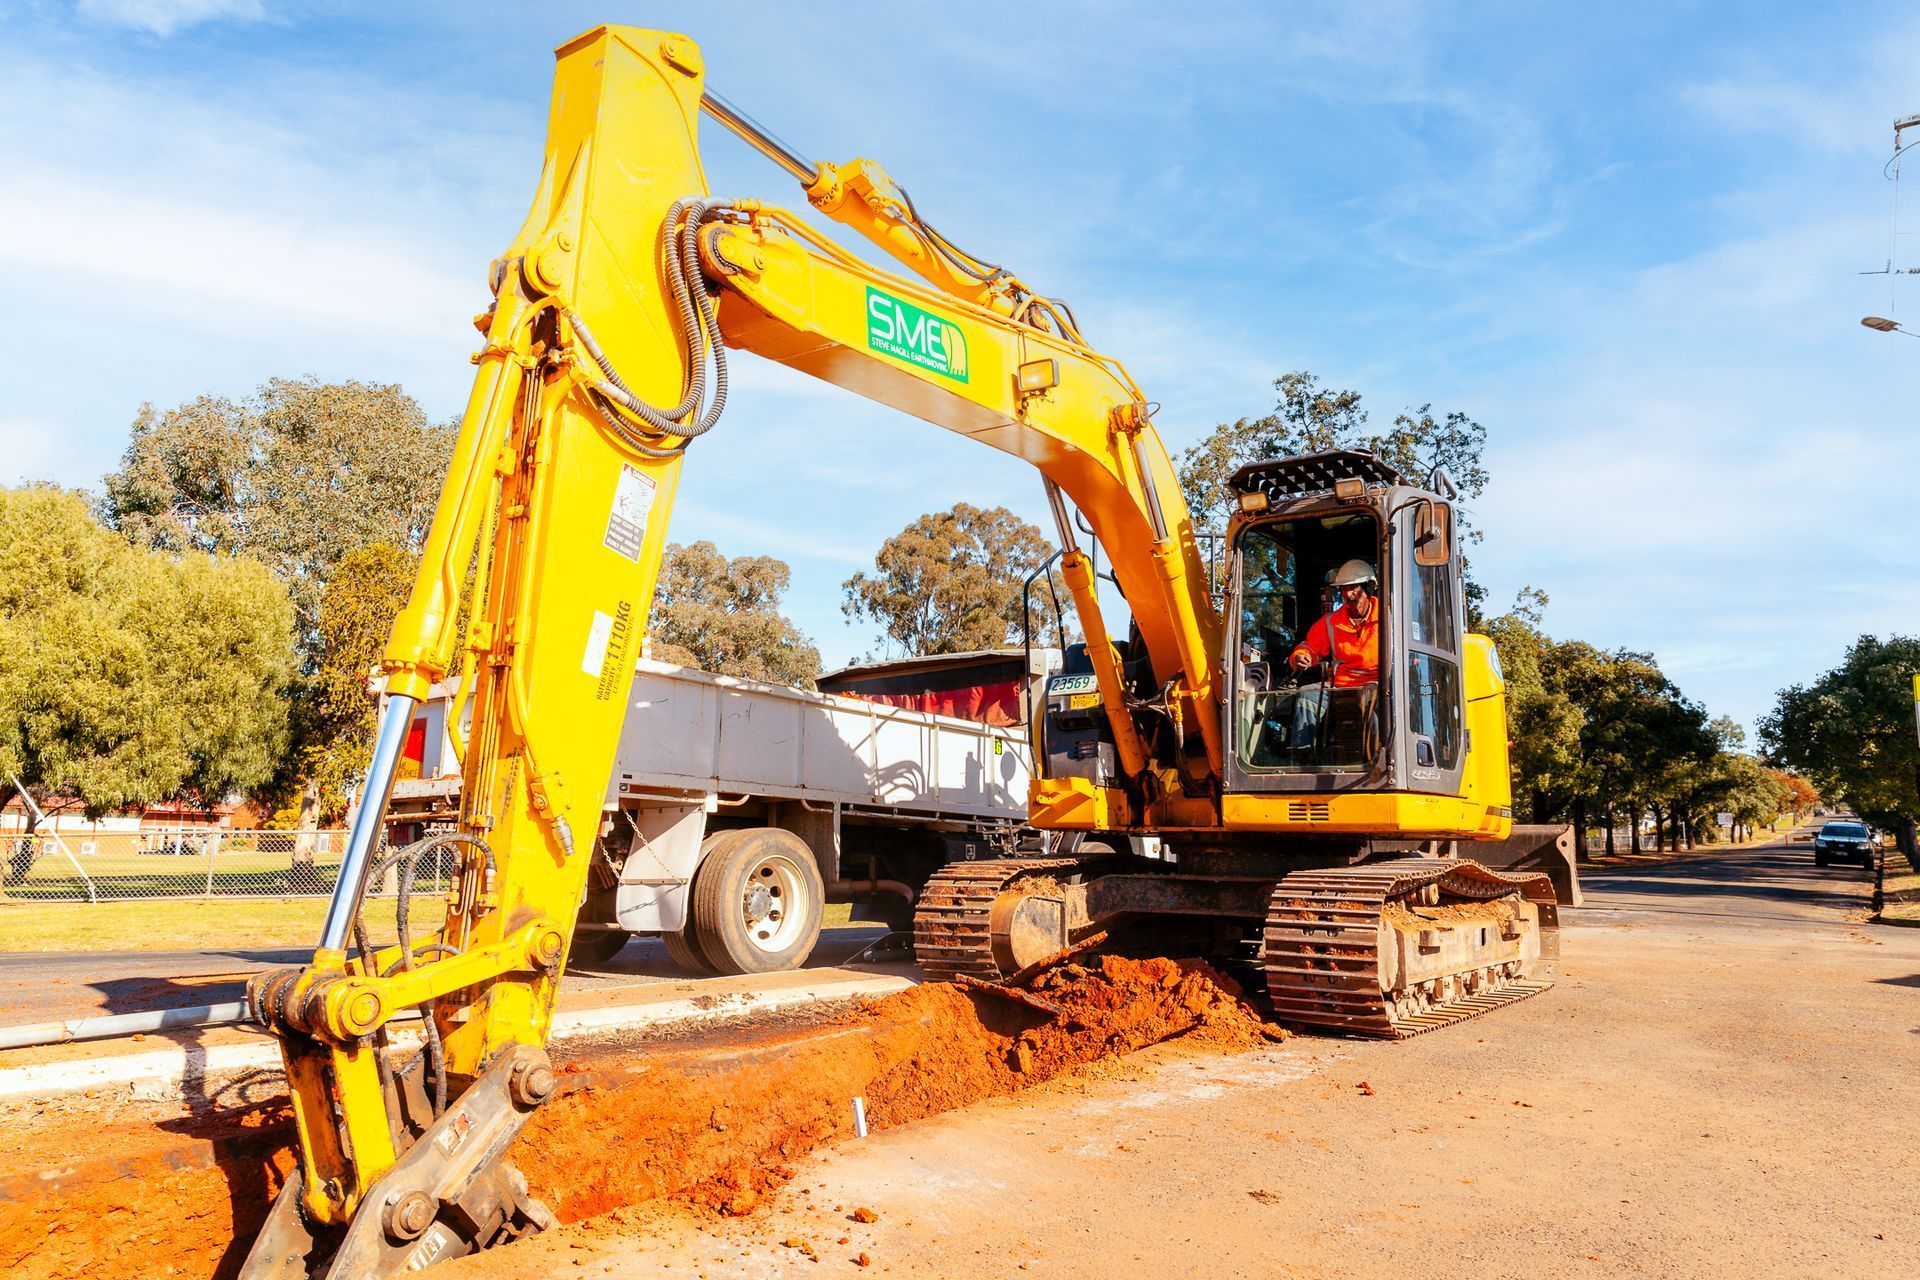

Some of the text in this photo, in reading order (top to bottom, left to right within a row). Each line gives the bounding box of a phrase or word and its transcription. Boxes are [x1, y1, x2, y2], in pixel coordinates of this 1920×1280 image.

[869, 294, 947, 362] SME
[871, 336, 889, 351] STEVE
[607, 600, 631, 660] 1110KG
[596, 661, 610, 700] RATED LIFT
[603, 667, 616, 701] CAPACITY
[1051, 676, 1090, 691] 23569
